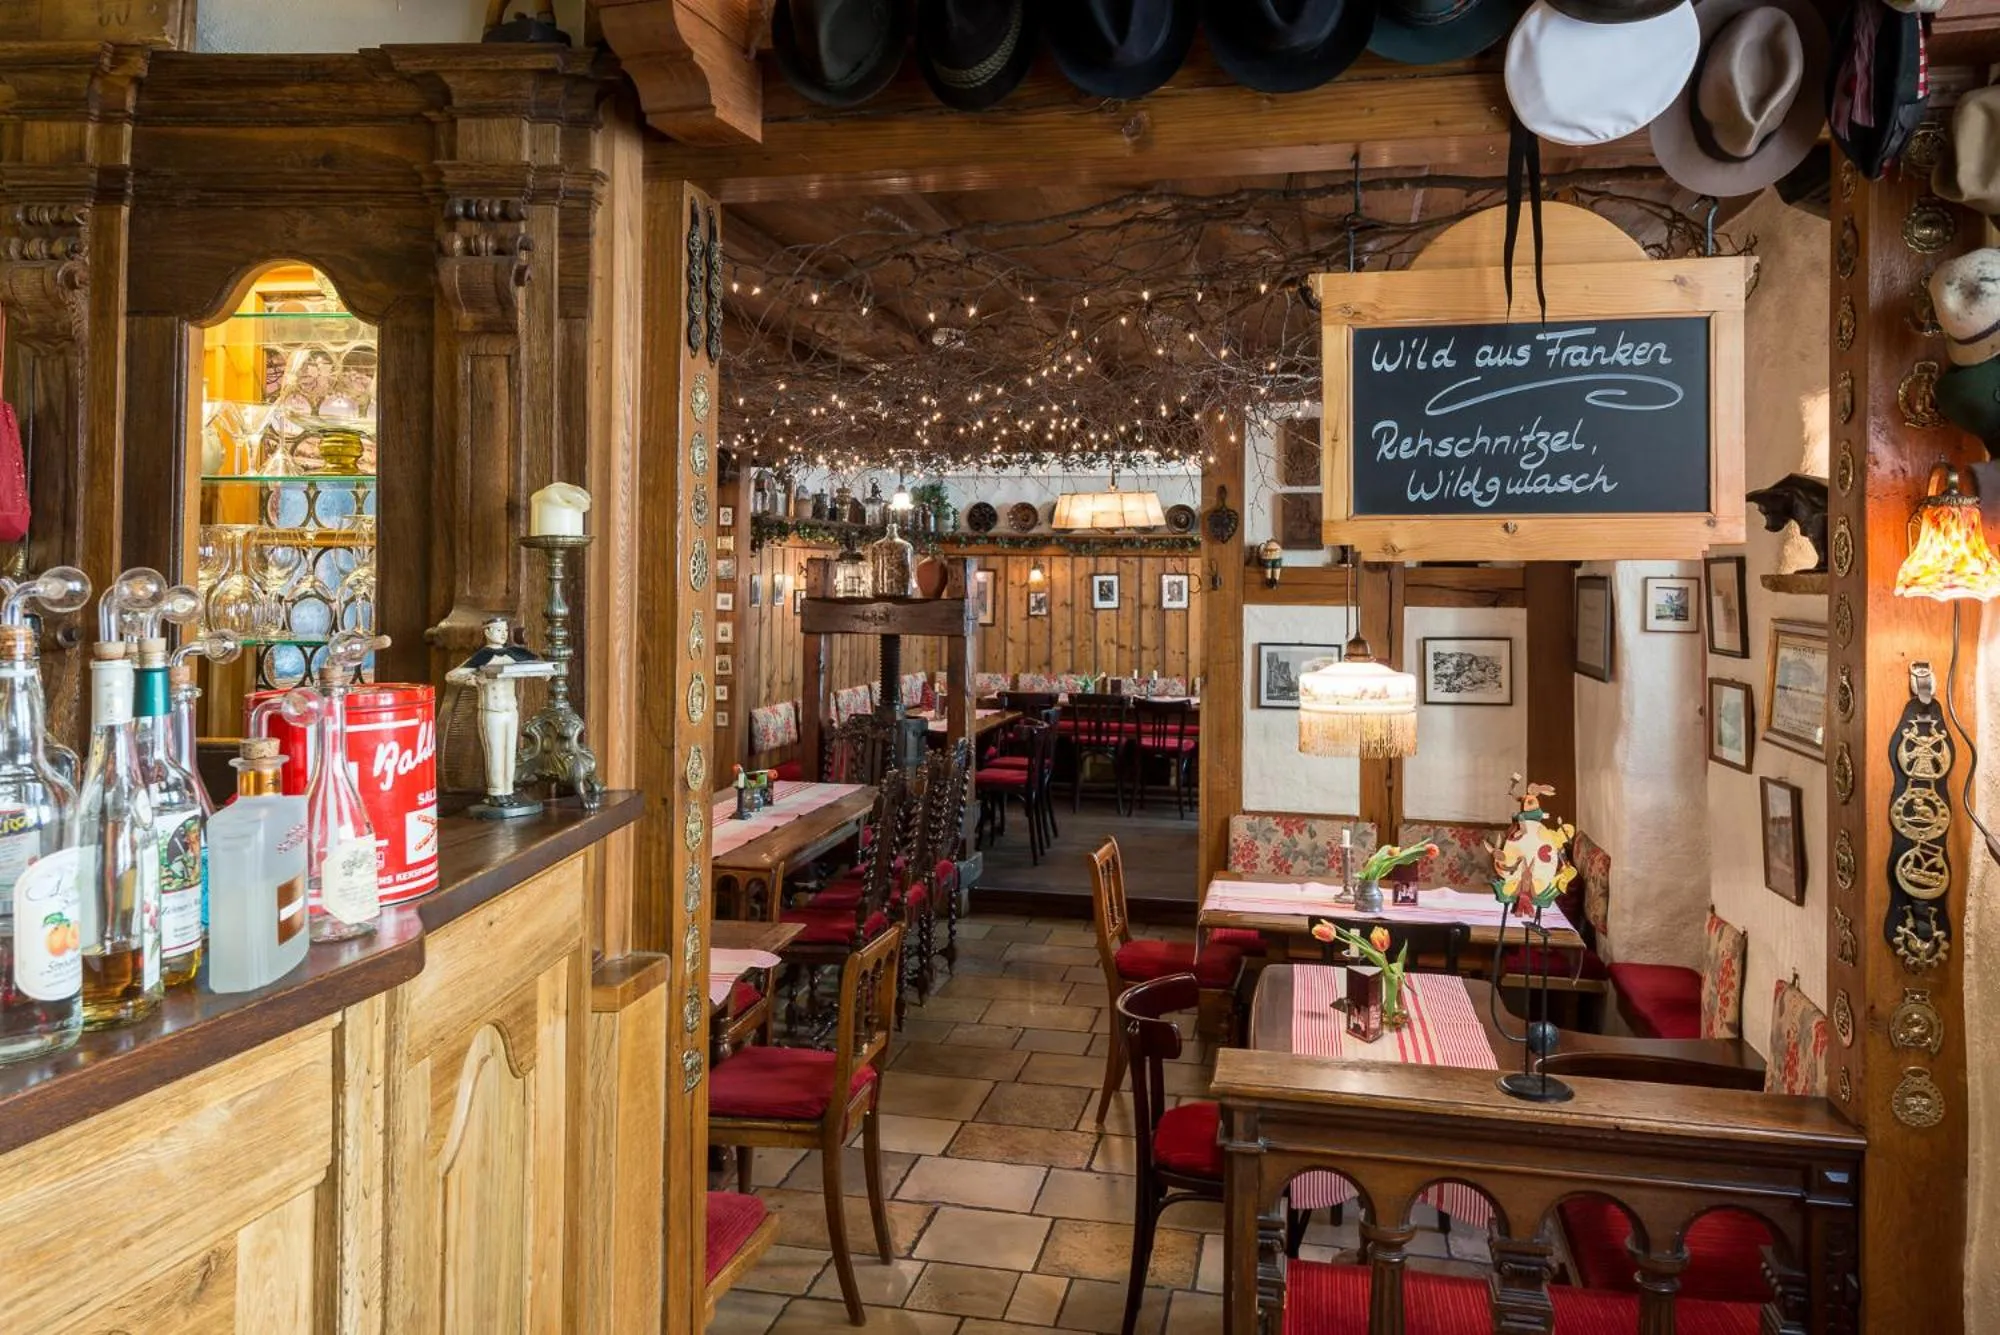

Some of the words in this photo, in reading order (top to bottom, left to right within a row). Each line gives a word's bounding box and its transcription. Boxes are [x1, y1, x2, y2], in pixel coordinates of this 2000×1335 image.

[1371, 336, 1457, 373] Wild
[1474, 343, 1532, 368] aus
[1535, 327, 1673, 369] Franken
[1406, 464, 1618, 508] Wildgulasch
